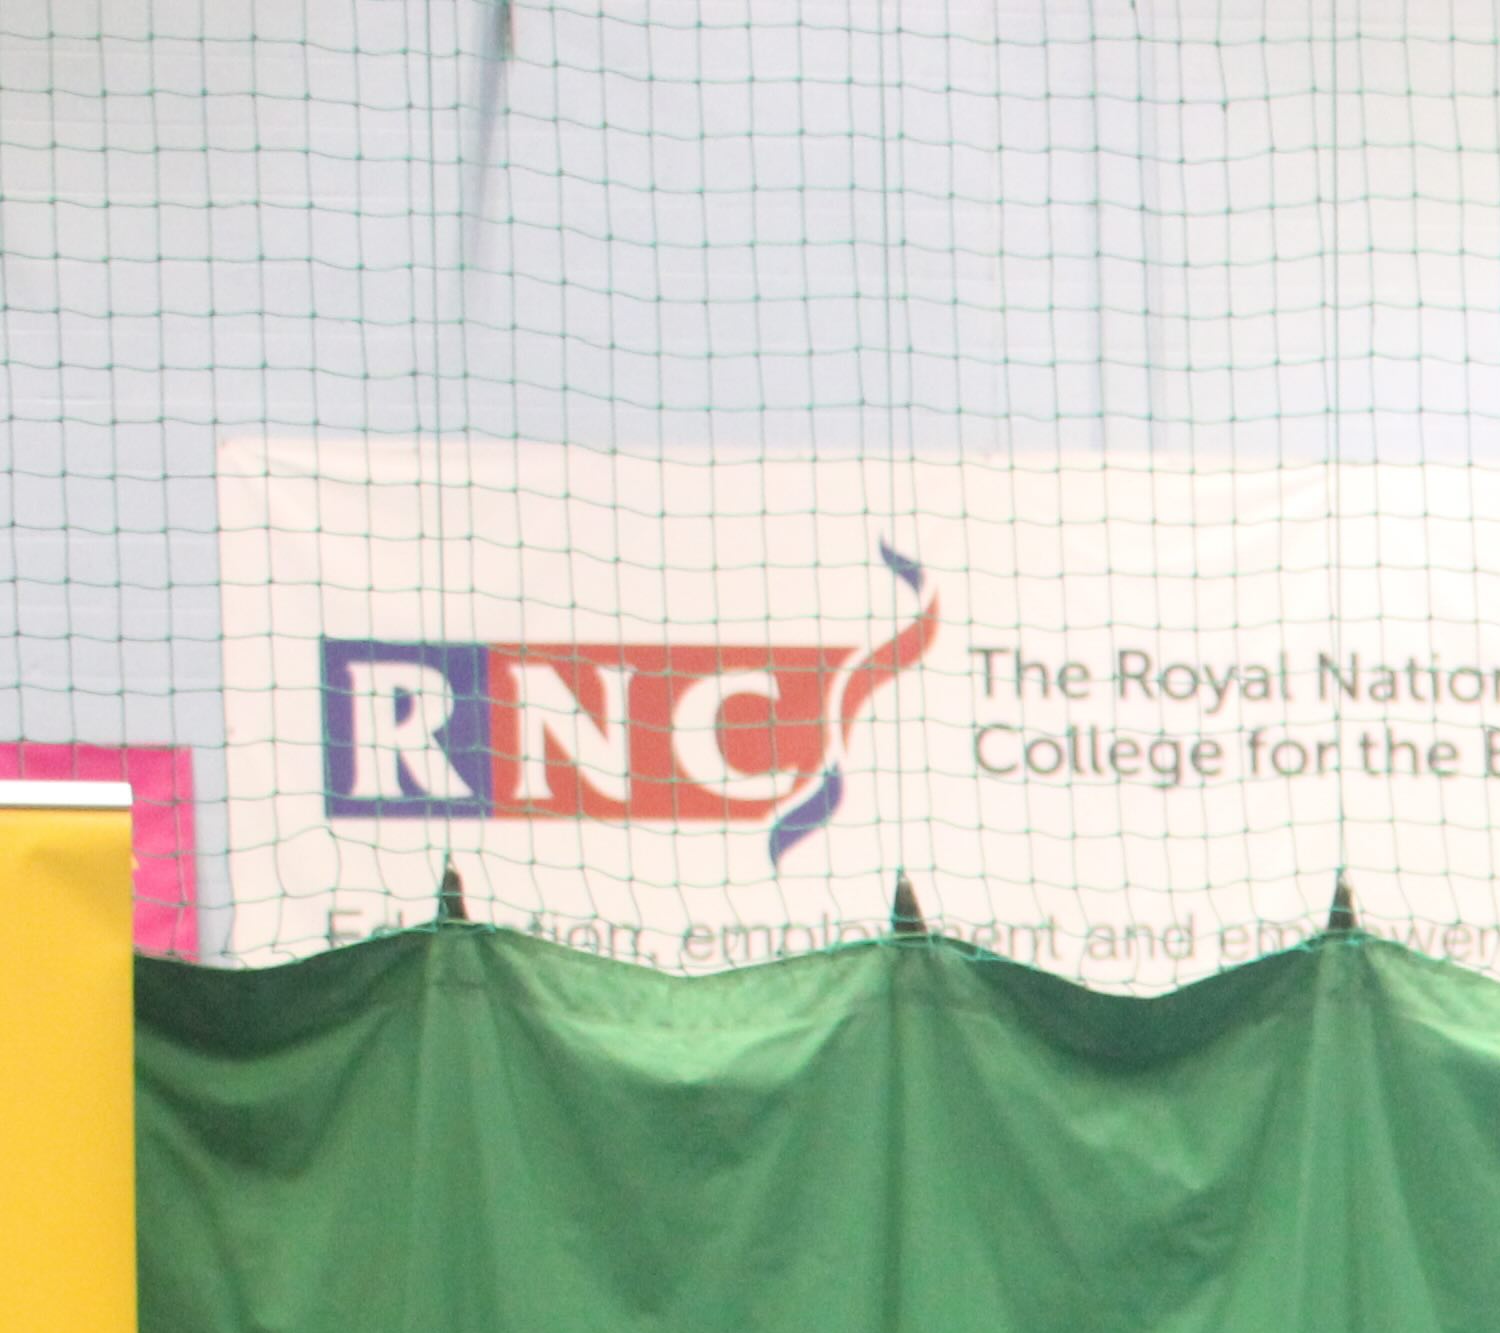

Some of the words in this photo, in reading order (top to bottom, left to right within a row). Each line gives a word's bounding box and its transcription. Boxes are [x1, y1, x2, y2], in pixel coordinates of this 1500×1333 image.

[968, 646, 1091, 702] The
[1116, 648, 1294, 717] Royal
[346, 660, 800, 803] RNC
[972, 724, 1225, 789] College
[1248, 727, 1339, 776] for
[1361, 727, 1461, 777] the
[1086, 913, 1196, 961] and
